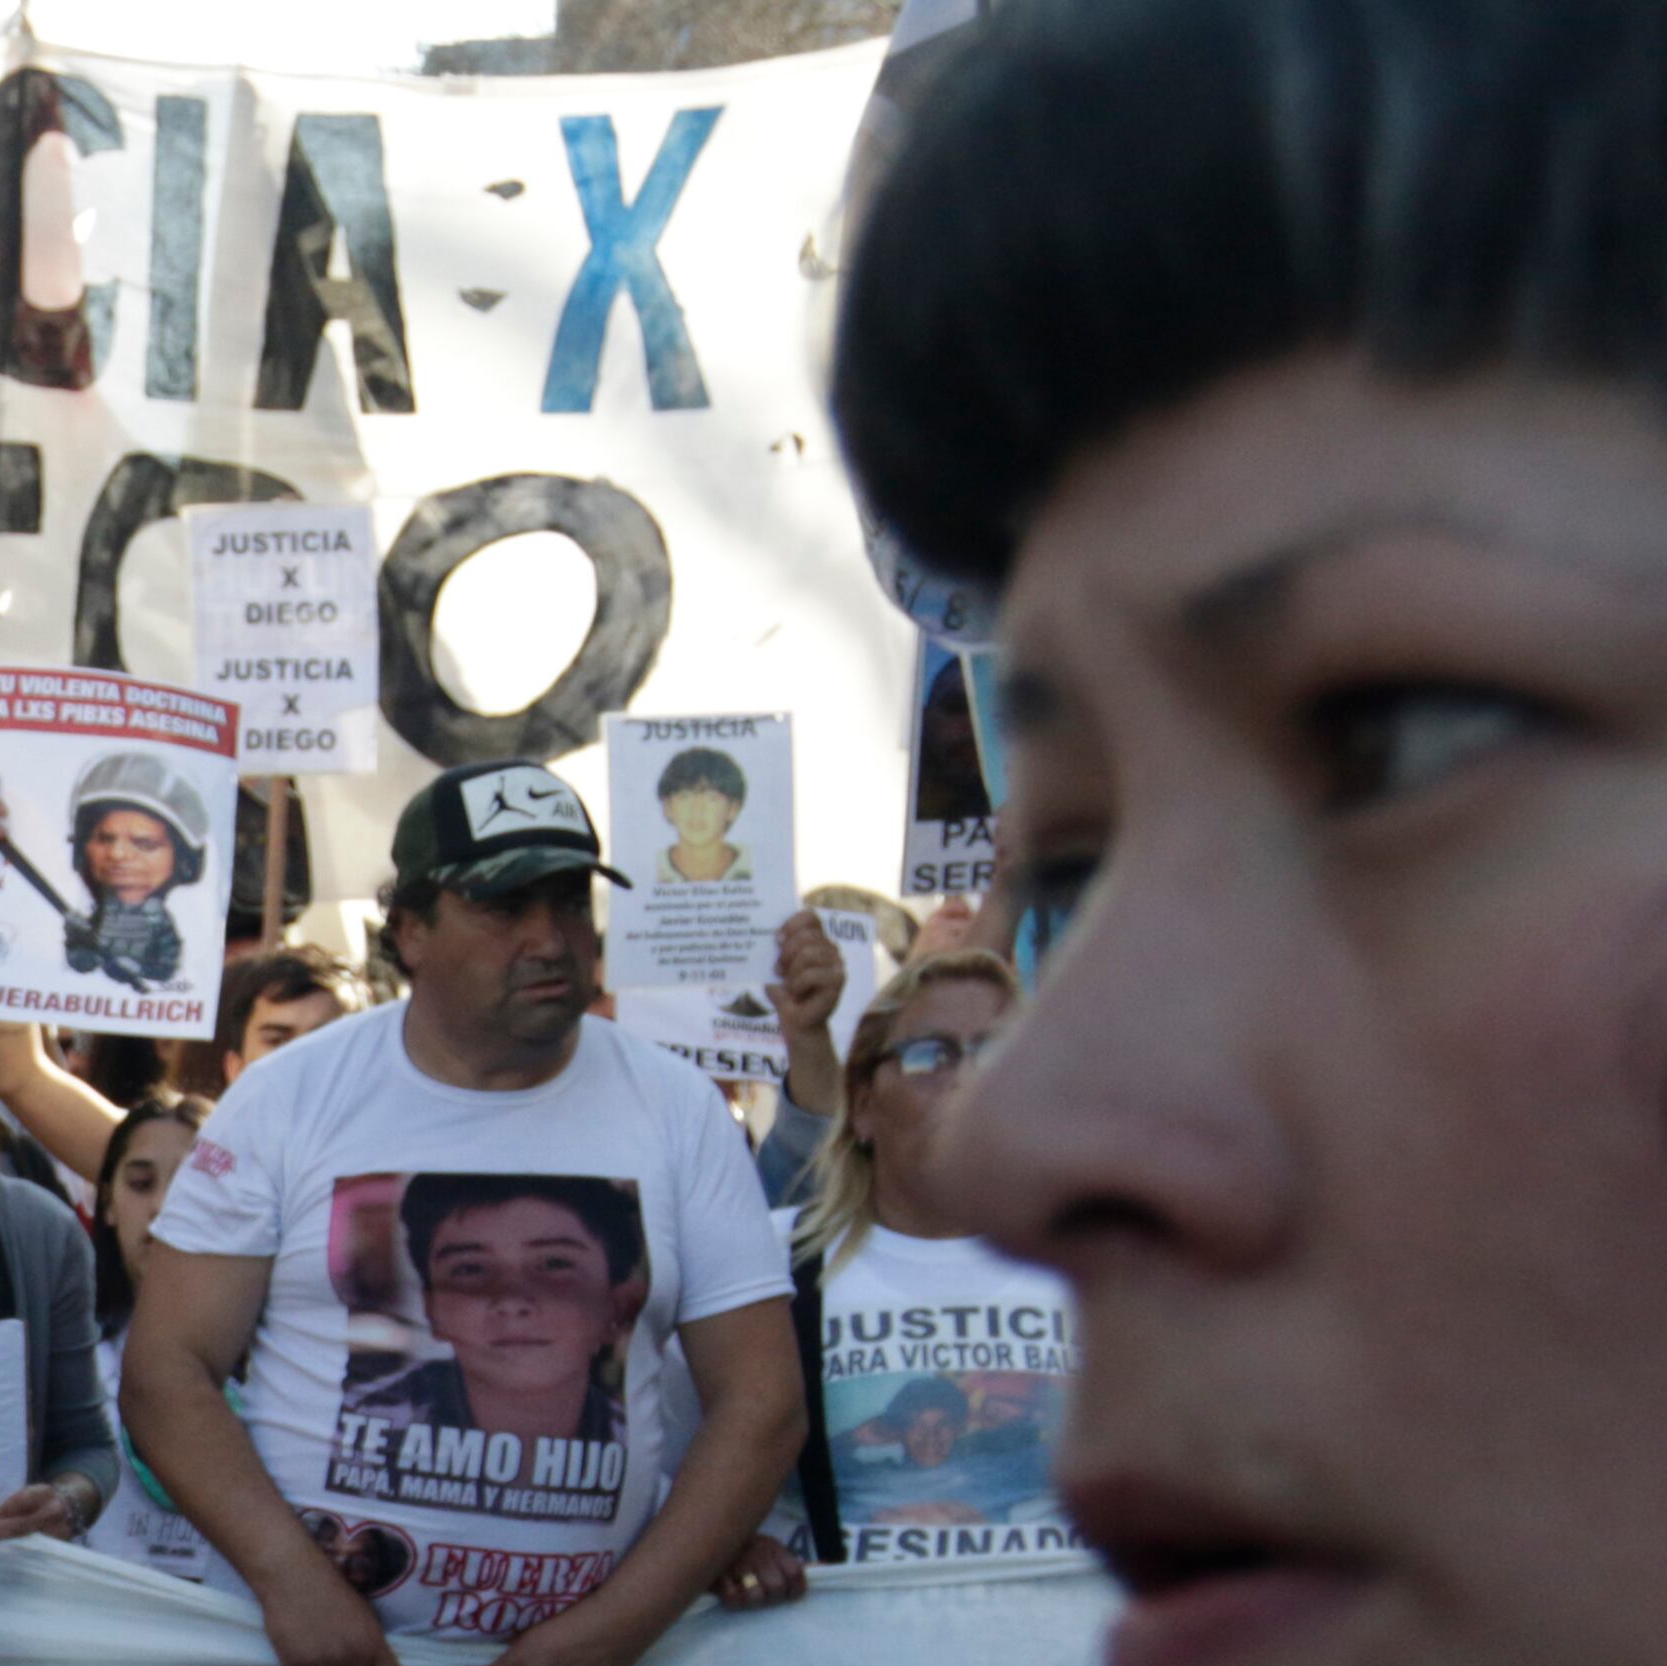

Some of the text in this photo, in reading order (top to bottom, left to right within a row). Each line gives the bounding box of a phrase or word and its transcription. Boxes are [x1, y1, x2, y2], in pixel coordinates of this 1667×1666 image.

[539, 105, 726, 413] X
[213, 529, 353, 556] JUSTICIA
[281, 565, 301, 589] X
[244, 600, 339, 626] DIEGO
[216, 658, 354, 682] JUSTICIA
[18, 675, 121, 702] VIOLENTA
[124, 686, 229, 726] DOCTRINA
[282, 692, 301, 717] X
[12, 699, 56, 721] LXS
[59, 702, 127, 728] PIBXS
[128, 708, 220, 744] ASESINA
[641, 719, 759, 742] JUSTICIA
[244, 727, 338, 751] DIEGO
[819, 1347, 889, 1382] ARA
[899, 1341, 1015, 1371] VICTOR
[340, 1411, 626, 1491] TE AMO HIJO
[483, 1485, 502, 1509] Y
[502, 1488, 615, 1519] HERMANOS
[421, 1542, 615, 1597] FUERZA
